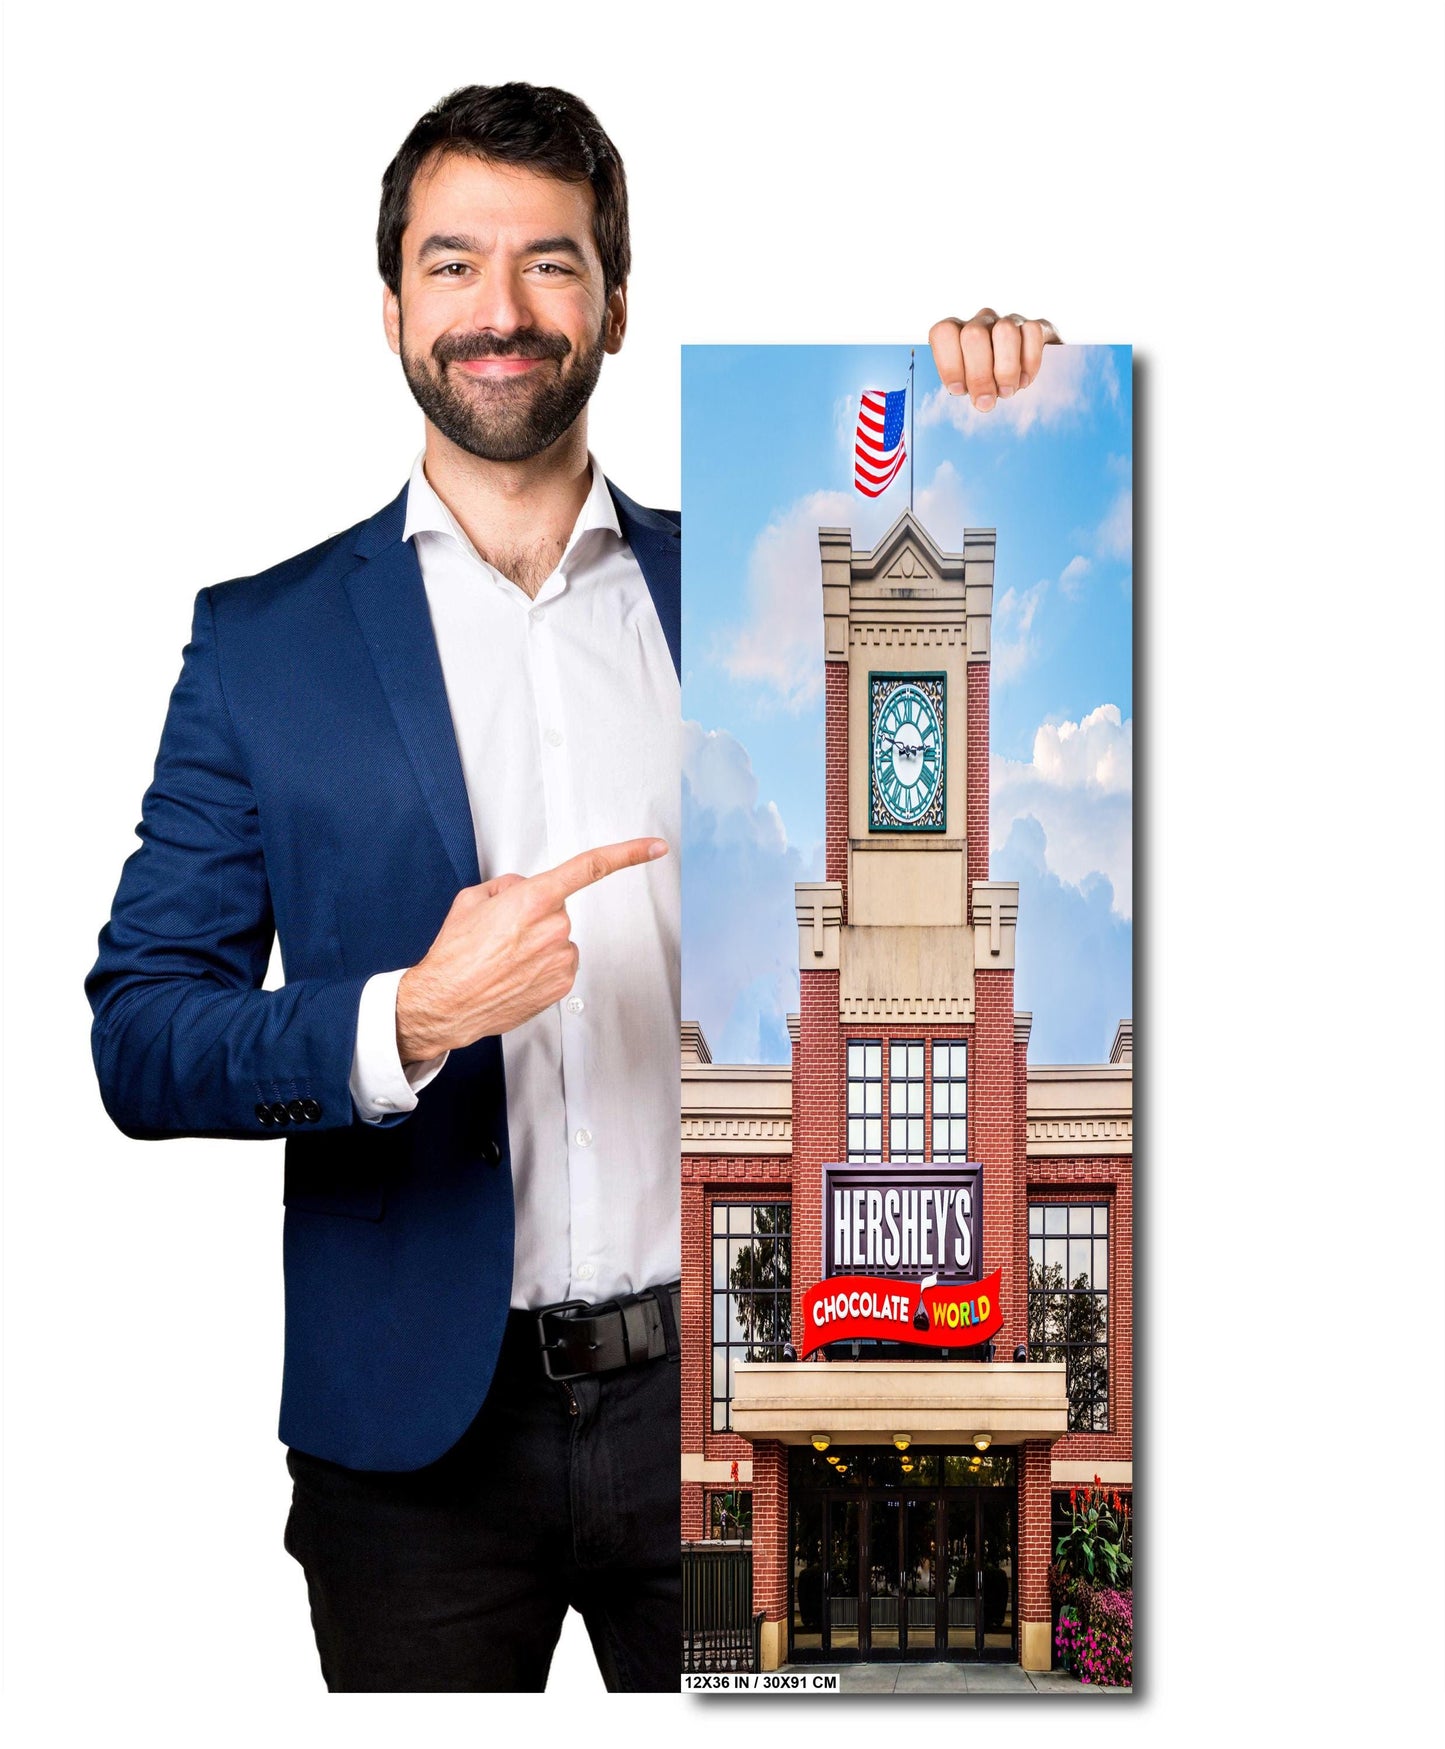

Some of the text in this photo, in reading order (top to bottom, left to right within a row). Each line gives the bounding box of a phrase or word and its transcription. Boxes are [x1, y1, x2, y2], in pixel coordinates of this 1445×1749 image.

[834, 1188, 971, 1267] HERSHEY'S
[812, 1291, 991, 1328] CHOCOLATE WORLD
